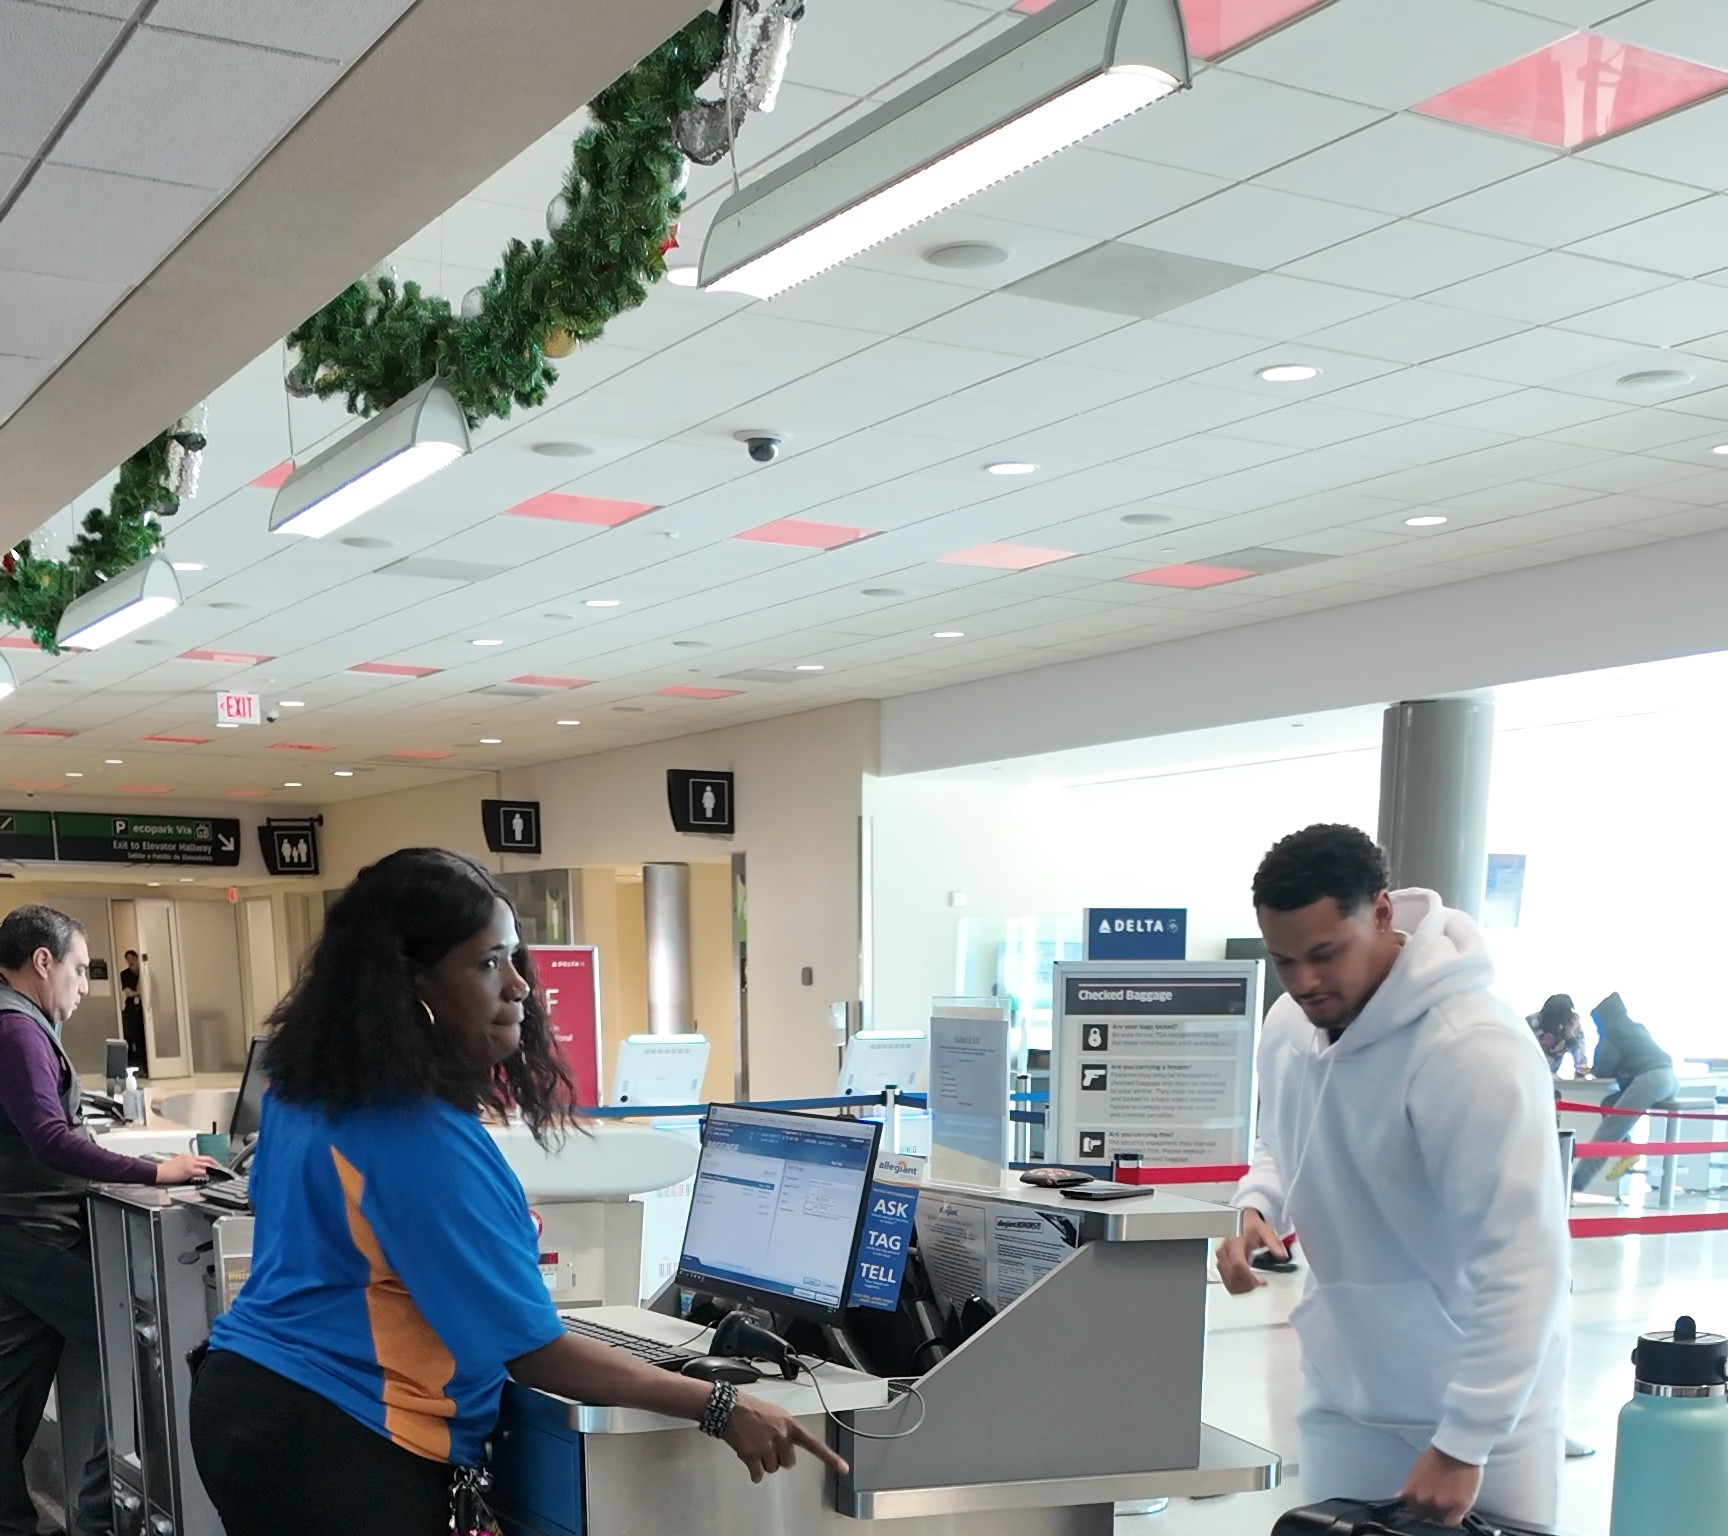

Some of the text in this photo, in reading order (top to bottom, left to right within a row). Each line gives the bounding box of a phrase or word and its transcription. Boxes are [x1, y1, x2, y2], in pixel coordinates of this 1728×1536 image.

[226, 695, 252, 718] EXIT
[115, 820, 192, 836] P ecopark Via
[112, 840, 212, 855] Exit to Elevator Hallway
[1114, 919, 1164, 933] DELTA
[1078, 989, 1173, 1002] Checked Baggage
[878, 1160, 917, 1175] allegiant
[873, 1199, 909, 1218] ASK
[868, 1230, 902, 1251] TAG
[860, 1262, 896, 1284] TELL
